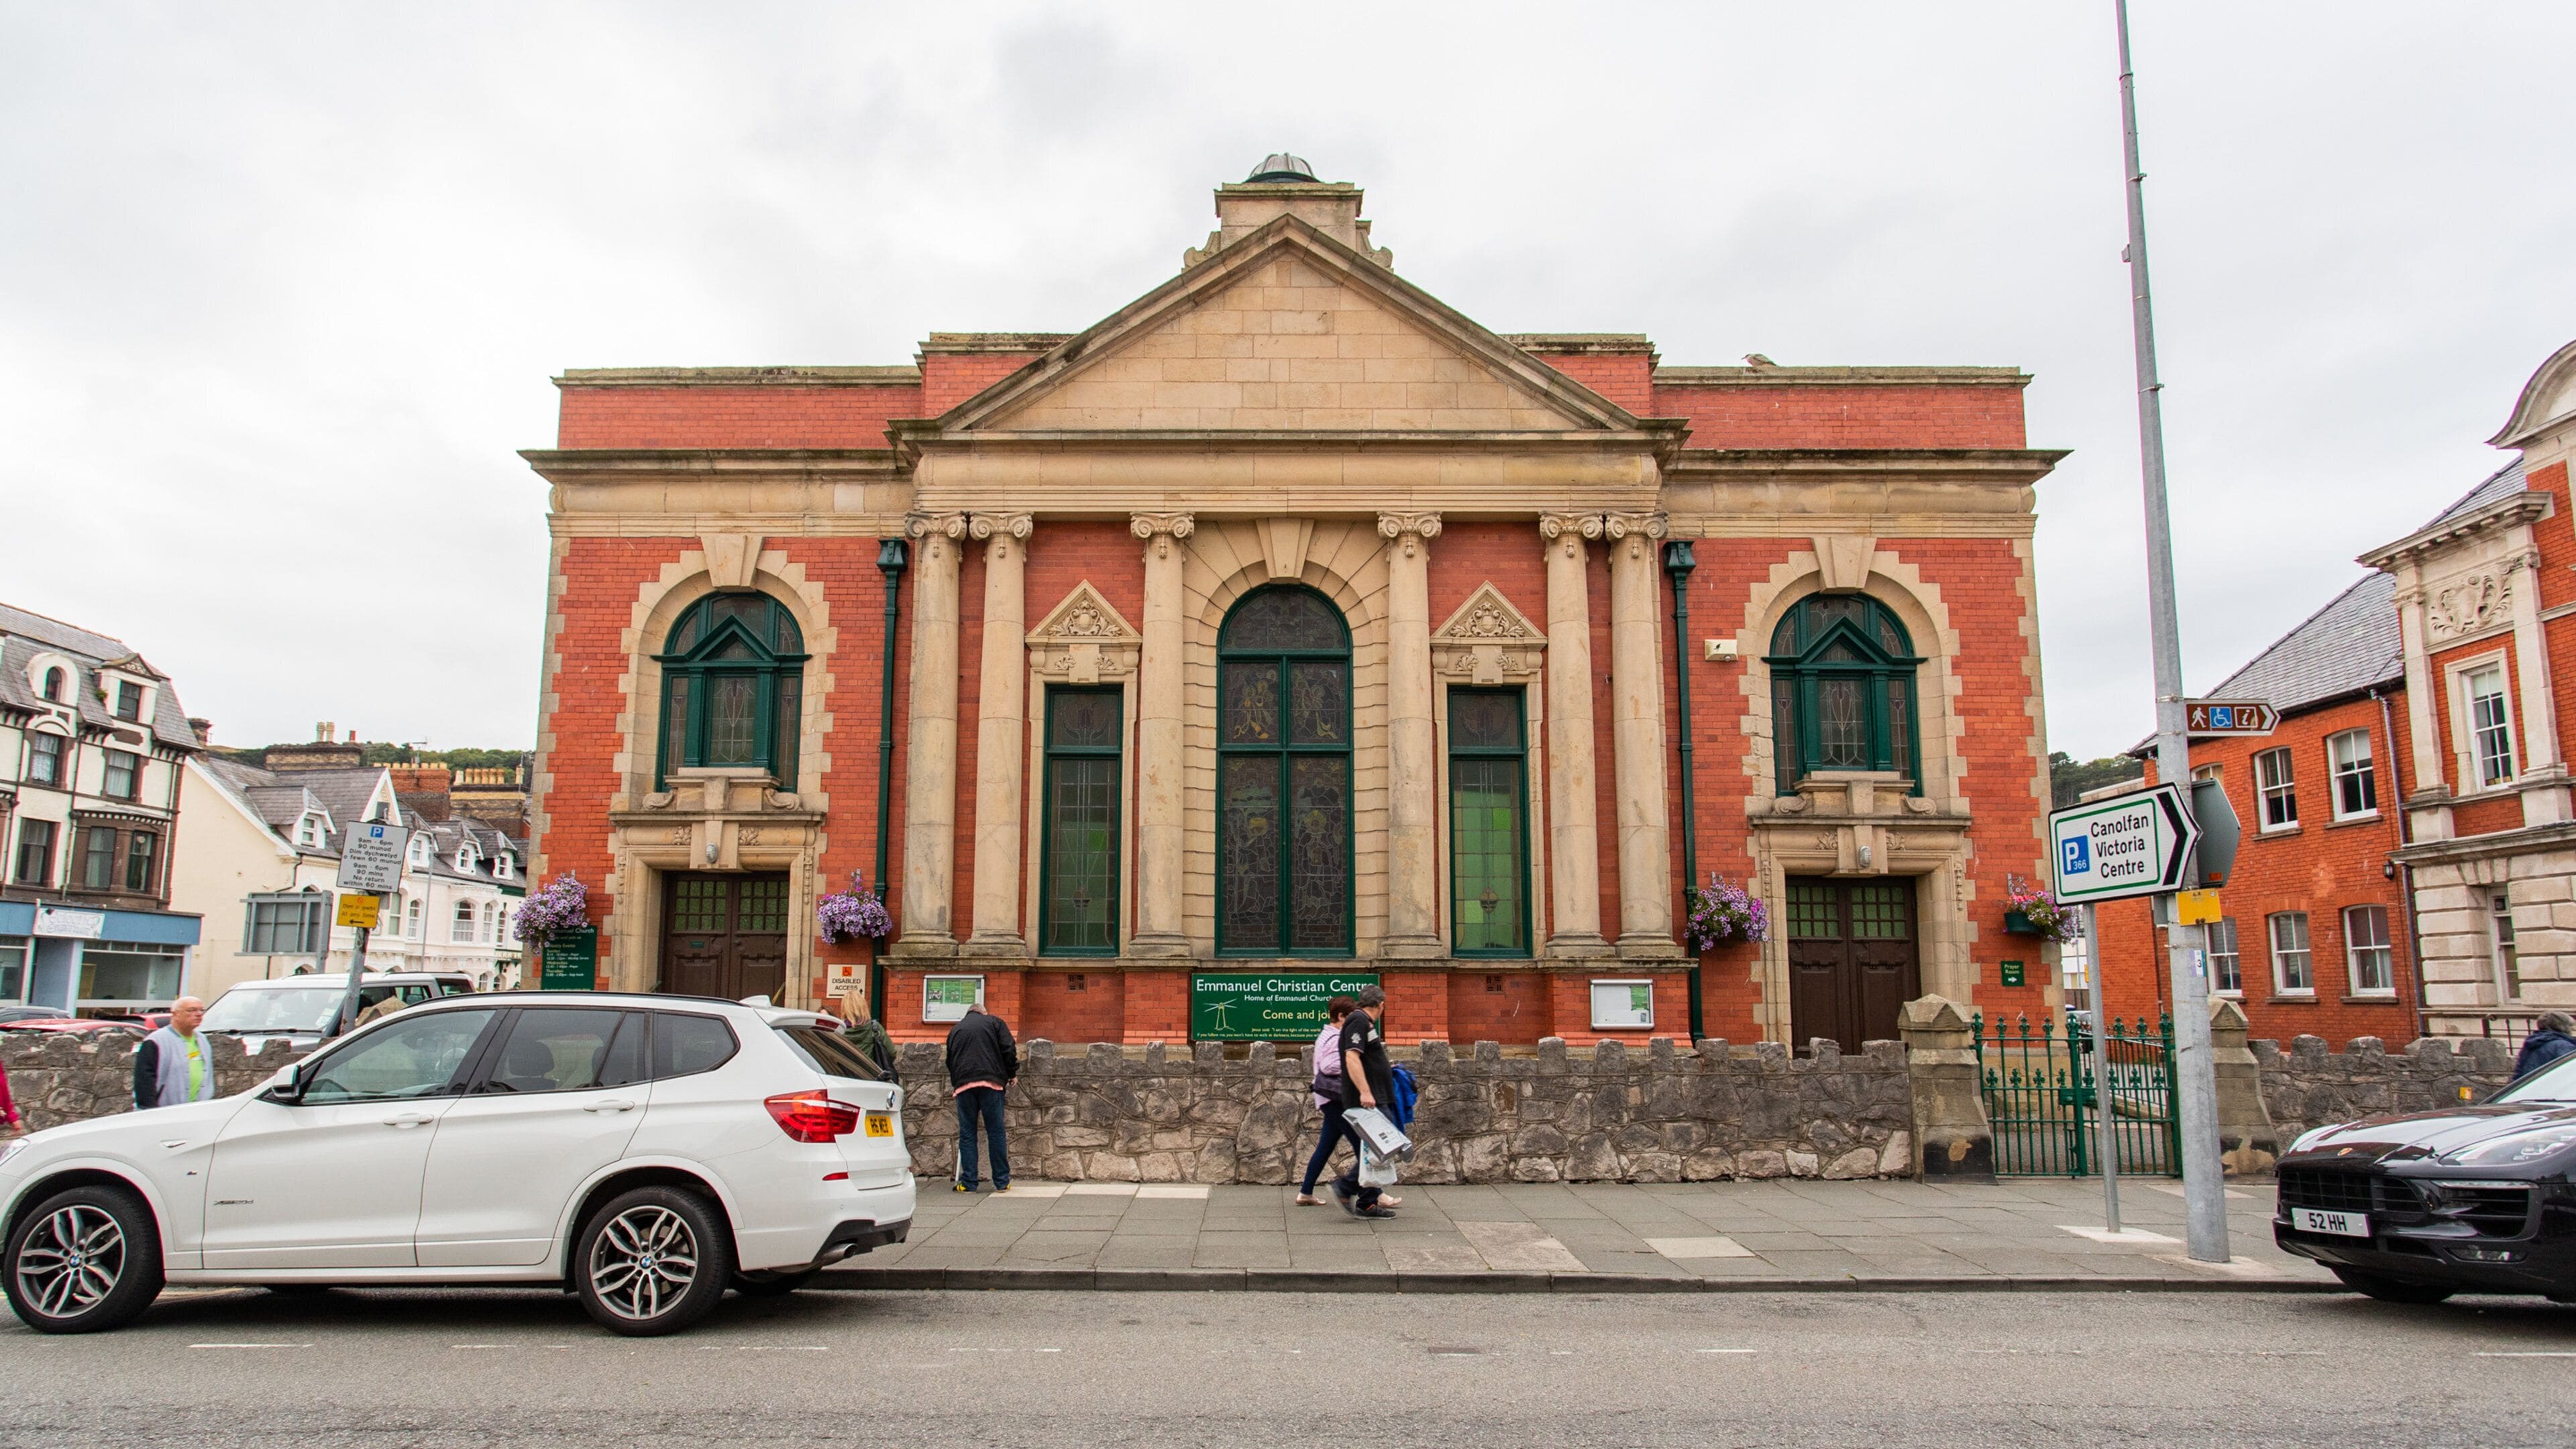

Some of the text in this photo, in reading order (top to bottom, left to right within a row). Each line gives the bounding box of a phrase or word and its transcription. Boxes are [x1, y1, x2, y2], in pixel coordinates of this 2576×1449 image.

[373, 826, 382, 837] P
[2090, 814, 2149, 837] Canolfan
[2096, 836, 2145, 858] Victoria
[364, 851, 397, 859] dychwelyd
[2065, 841, 2080, 871] P
[2073, 859, 2087, 870] 366
[2100, 859, 2145, 878] Centre
[1197, 979, 1374, 991] Emmanuel Christian Centr
[1263, 1010, 1330, 1021] Come and joi
[2308, 1212, 2347, 1232] 52 HH
